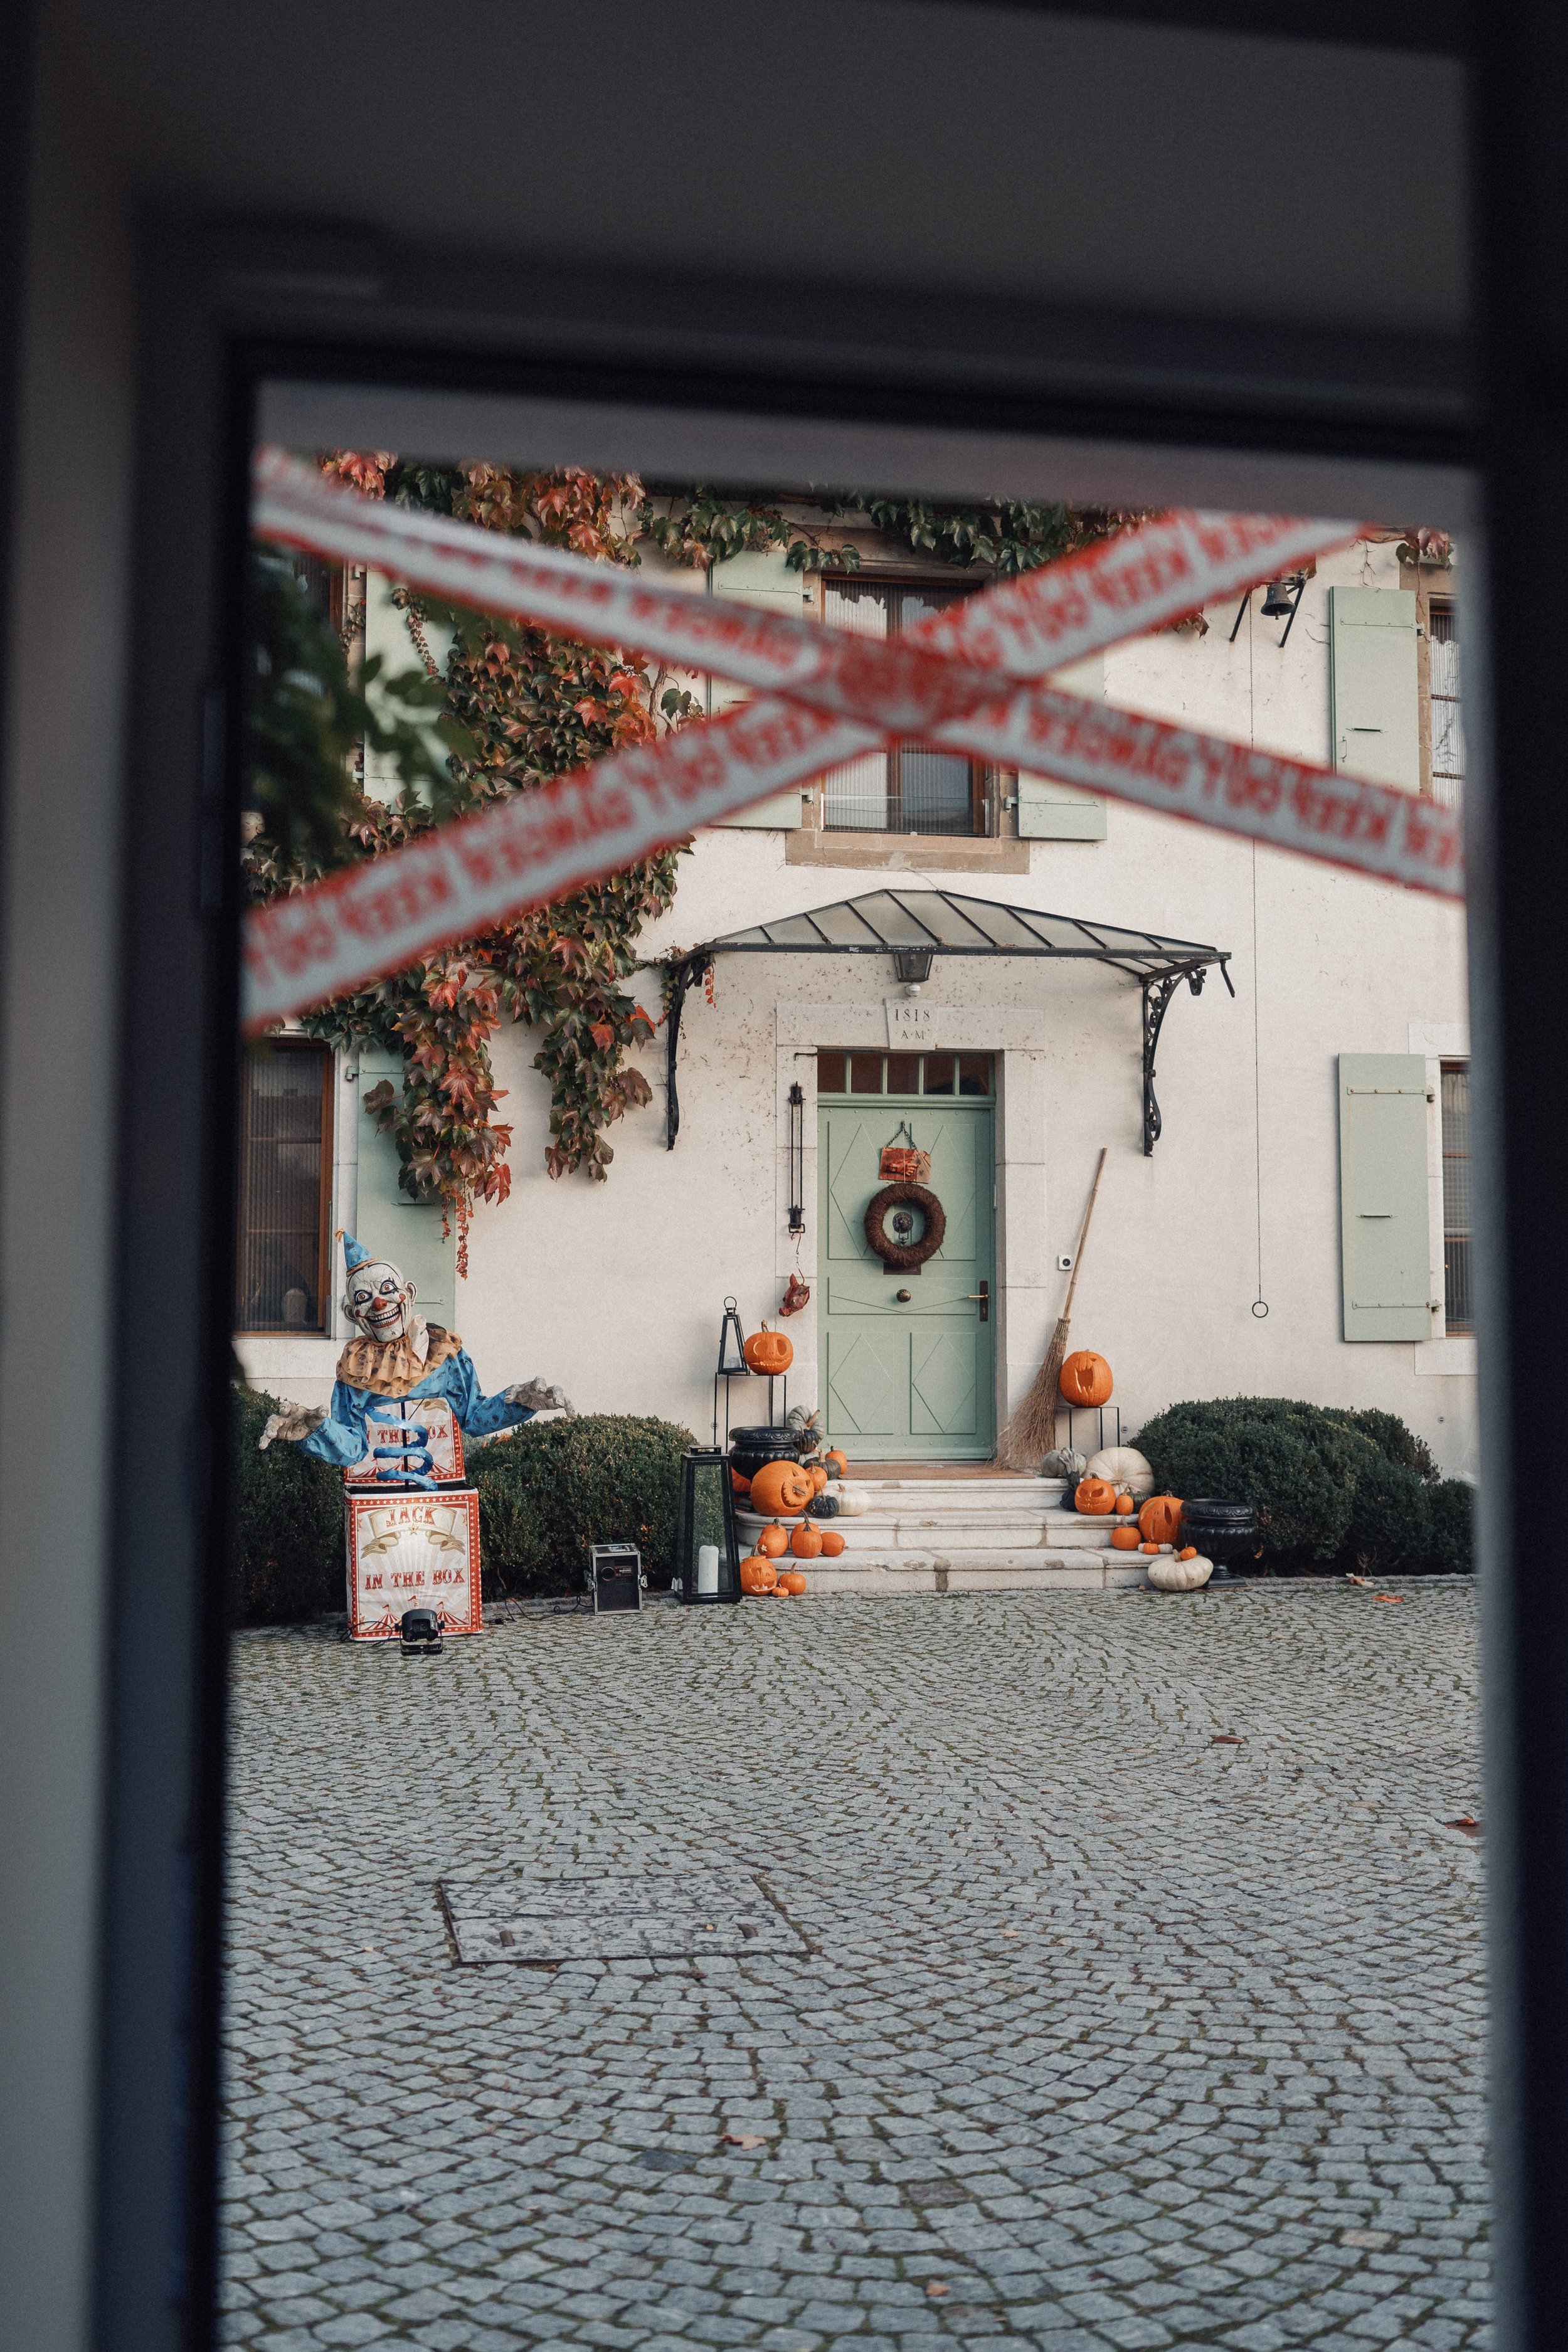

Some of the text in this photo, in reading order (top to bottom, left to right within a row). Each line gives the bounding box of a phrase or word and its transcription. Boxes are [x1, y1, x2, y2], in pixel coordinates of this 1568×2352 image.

[895, 1009, 930, 1022] 1818
[386, 1506, 438, 1527] JACK
[365, 1568, 466, 1590] IN THE BOX
